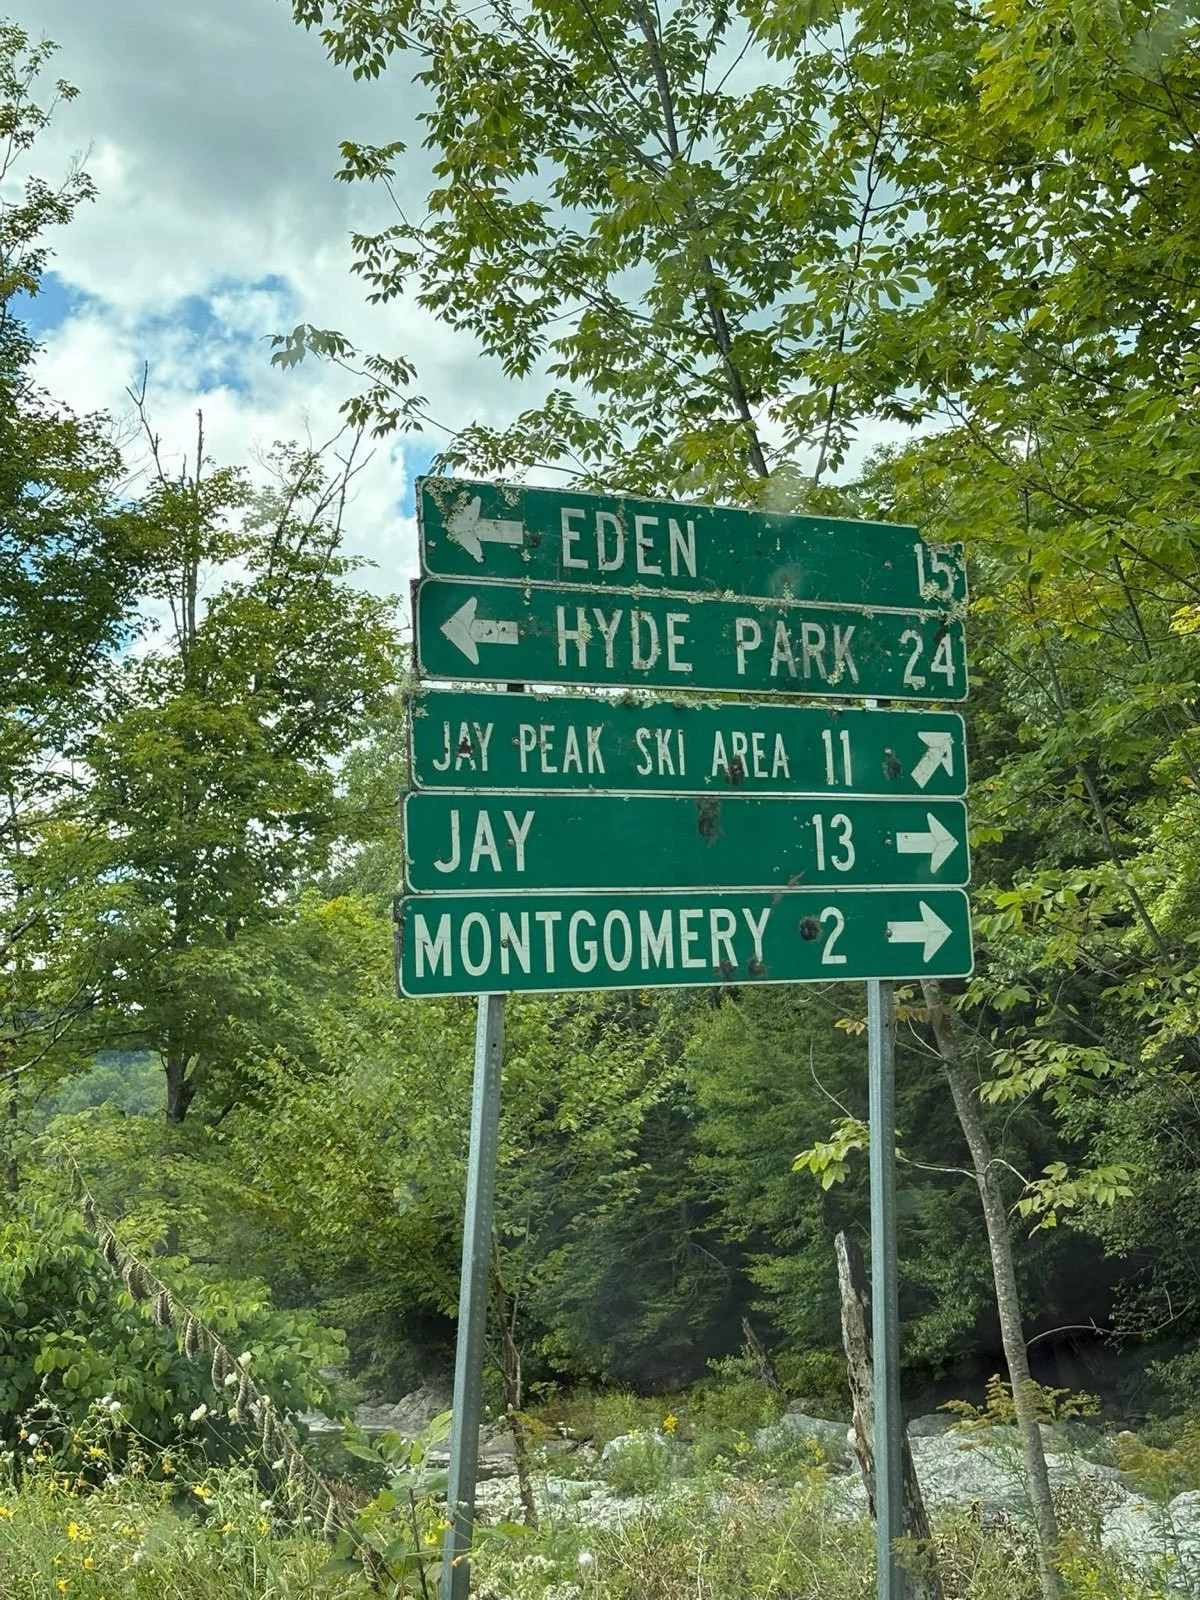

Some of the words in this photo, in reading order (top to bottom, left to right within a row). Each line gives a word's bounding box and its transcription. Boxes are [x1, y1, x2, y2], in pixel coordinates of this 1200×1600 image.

[560, 507, 698, 578] EDEN
[914, 542, 955, 600] 15
[556, 605, 693, 673] HYDE
[735, 617, 859, 684] PARK
[901, 629, 955, 689] 24
[432, 721, 494, 772] JAY
[519, 723, 606, 774] PEAK
[635, 727, 686, 776] SKI
[711, 730, 790, 779] AREA
[821, 729, 853, 787] 11
[433, 809, 535, 874] JAY
[811, 813, 856, 873] 13
[413, 907, 771, 979] MONTGOMERY
[819, 906, 848, 966] 2
